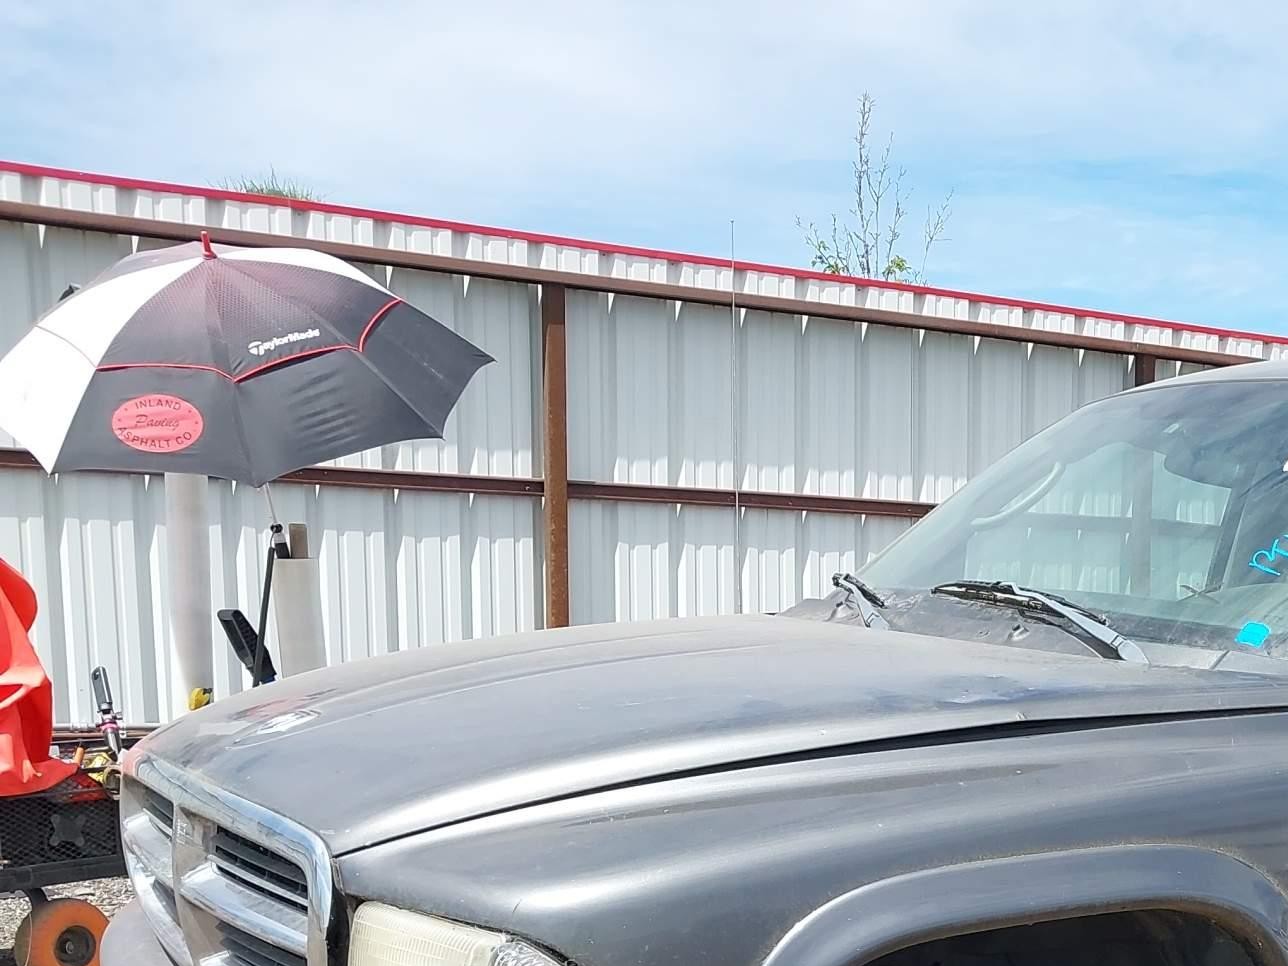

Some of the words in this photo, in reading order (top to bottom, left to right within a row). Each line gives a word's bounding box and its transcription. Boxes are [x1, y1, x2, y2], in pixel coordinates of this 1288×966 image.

[247, 328, 320, 356] TaylorMade
[135, 399, 181, 411] INLAND
[135, 413, 180, 431] Paving
[117, 427, 171, 449] ASPHALT
[175, 431, 192, 445] CO
